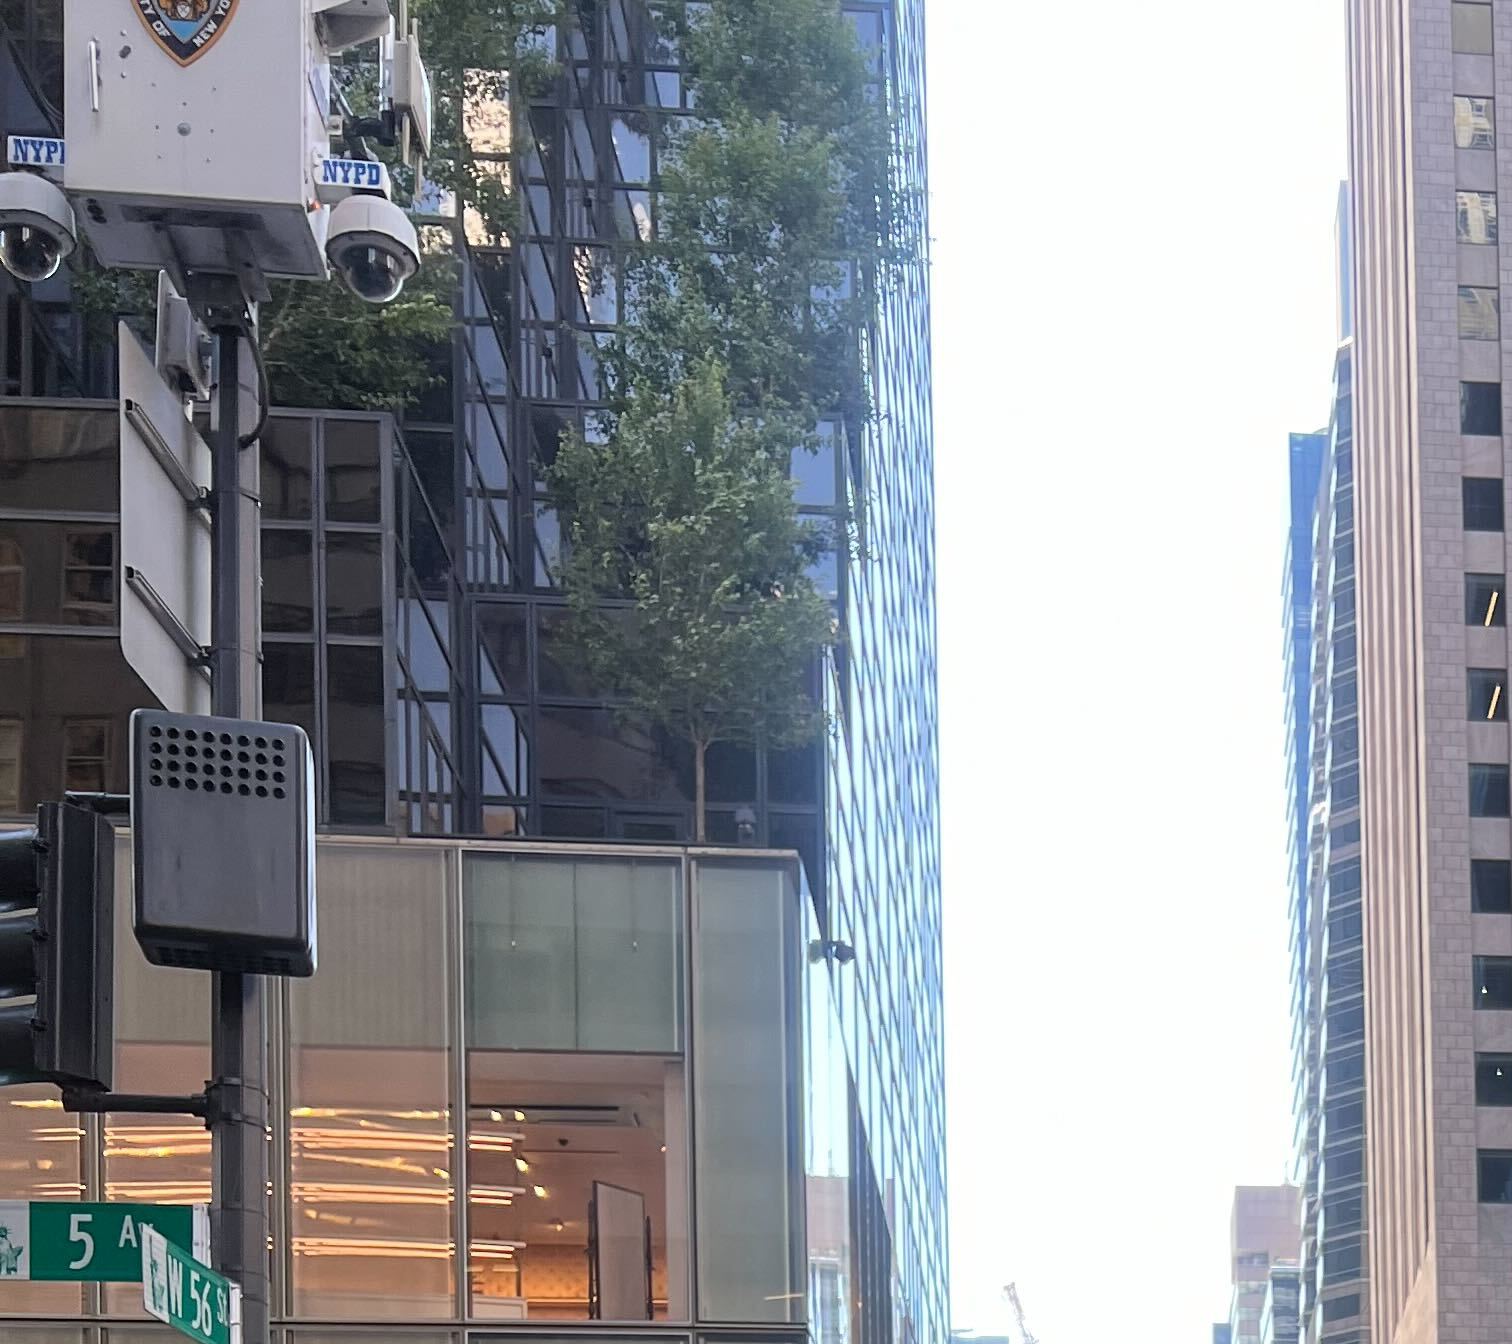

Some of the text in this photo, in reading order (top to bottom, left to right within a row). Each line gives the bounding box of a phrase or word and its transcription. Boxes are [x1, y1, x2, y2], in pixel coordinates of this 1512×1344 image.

[152, 20, 172, 37] OF
[192, 19, 218, 48] NEW
[323, 159, 380, 185] NYPD
[69, 1213, 154, 1270] 5 A
[167, 1253, 184, 1319] W
[190, 1269, 213, 1337] 56
